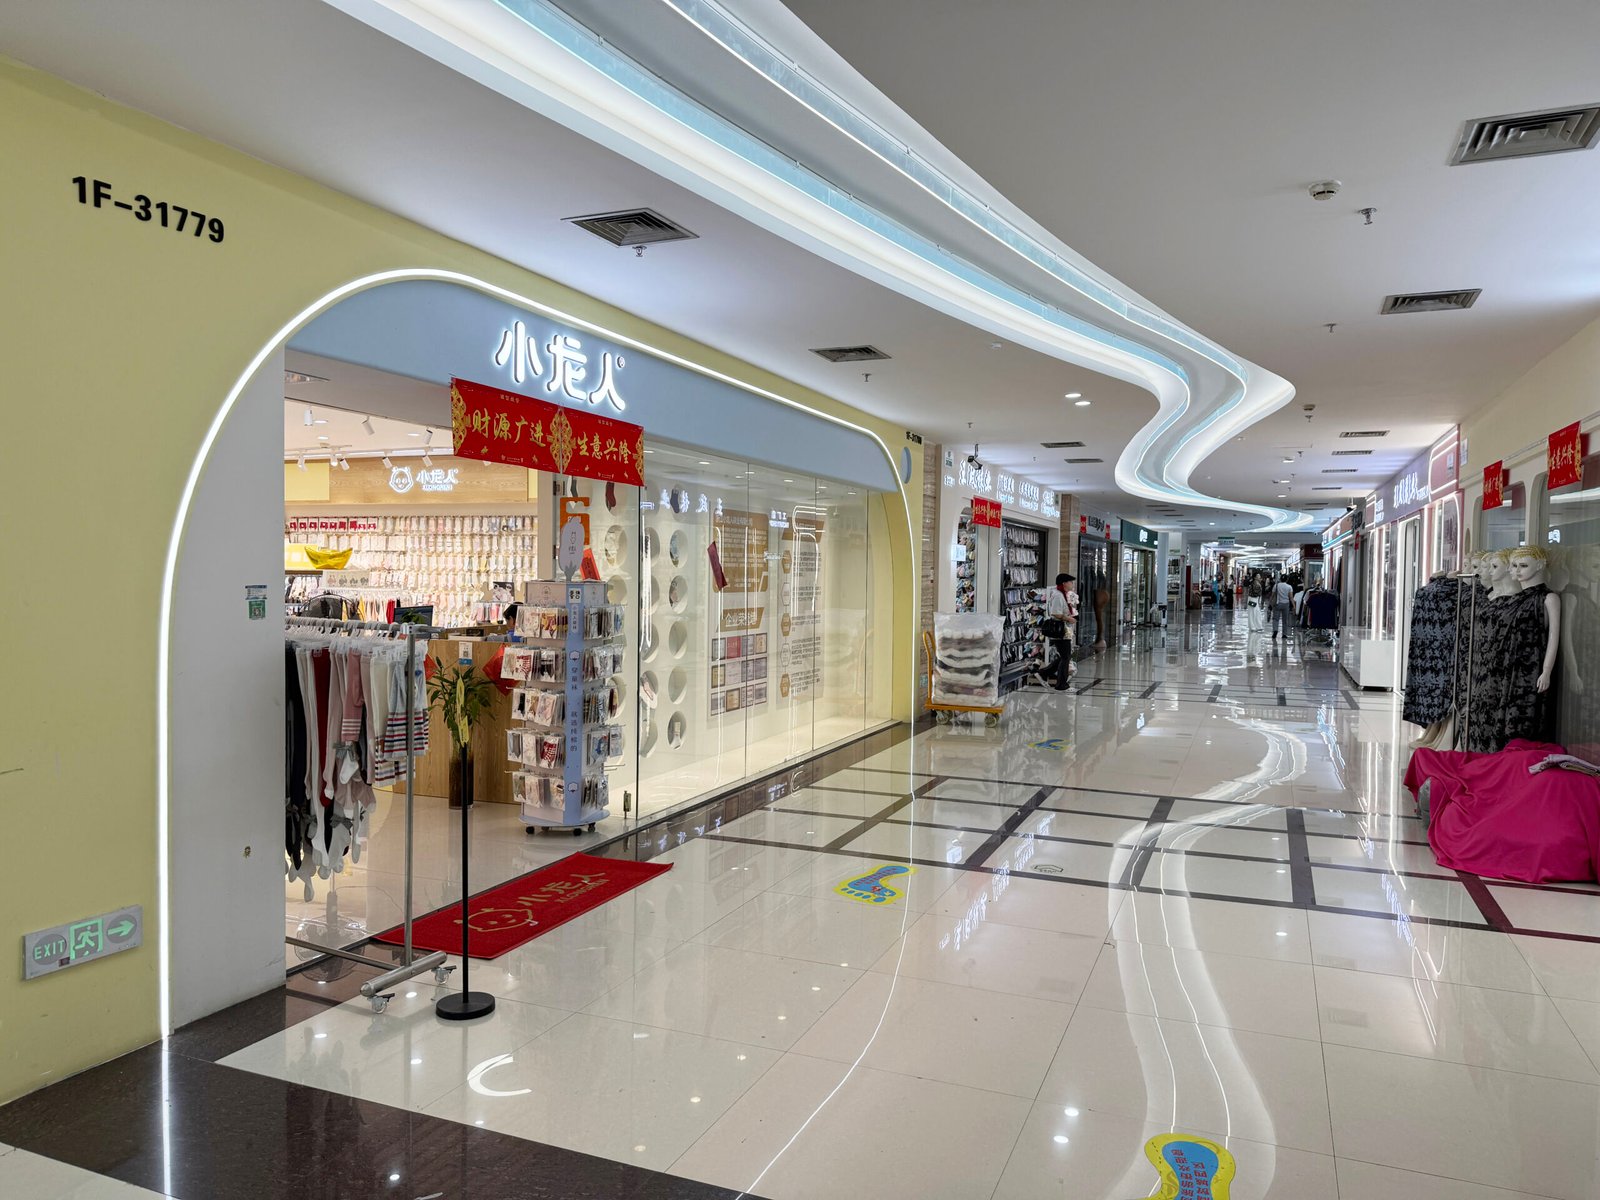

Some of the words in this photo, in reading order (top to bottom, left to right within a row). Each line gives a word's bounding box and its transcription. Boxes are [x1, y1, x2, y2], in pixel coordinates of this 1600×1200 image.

[72, 176, 225, 243] 1F-31779
[472, 408, 546, 448] 财源广进
[577, 432, 632, 464] 生意兴隆
[34, 940, 66, 960] EXIT
